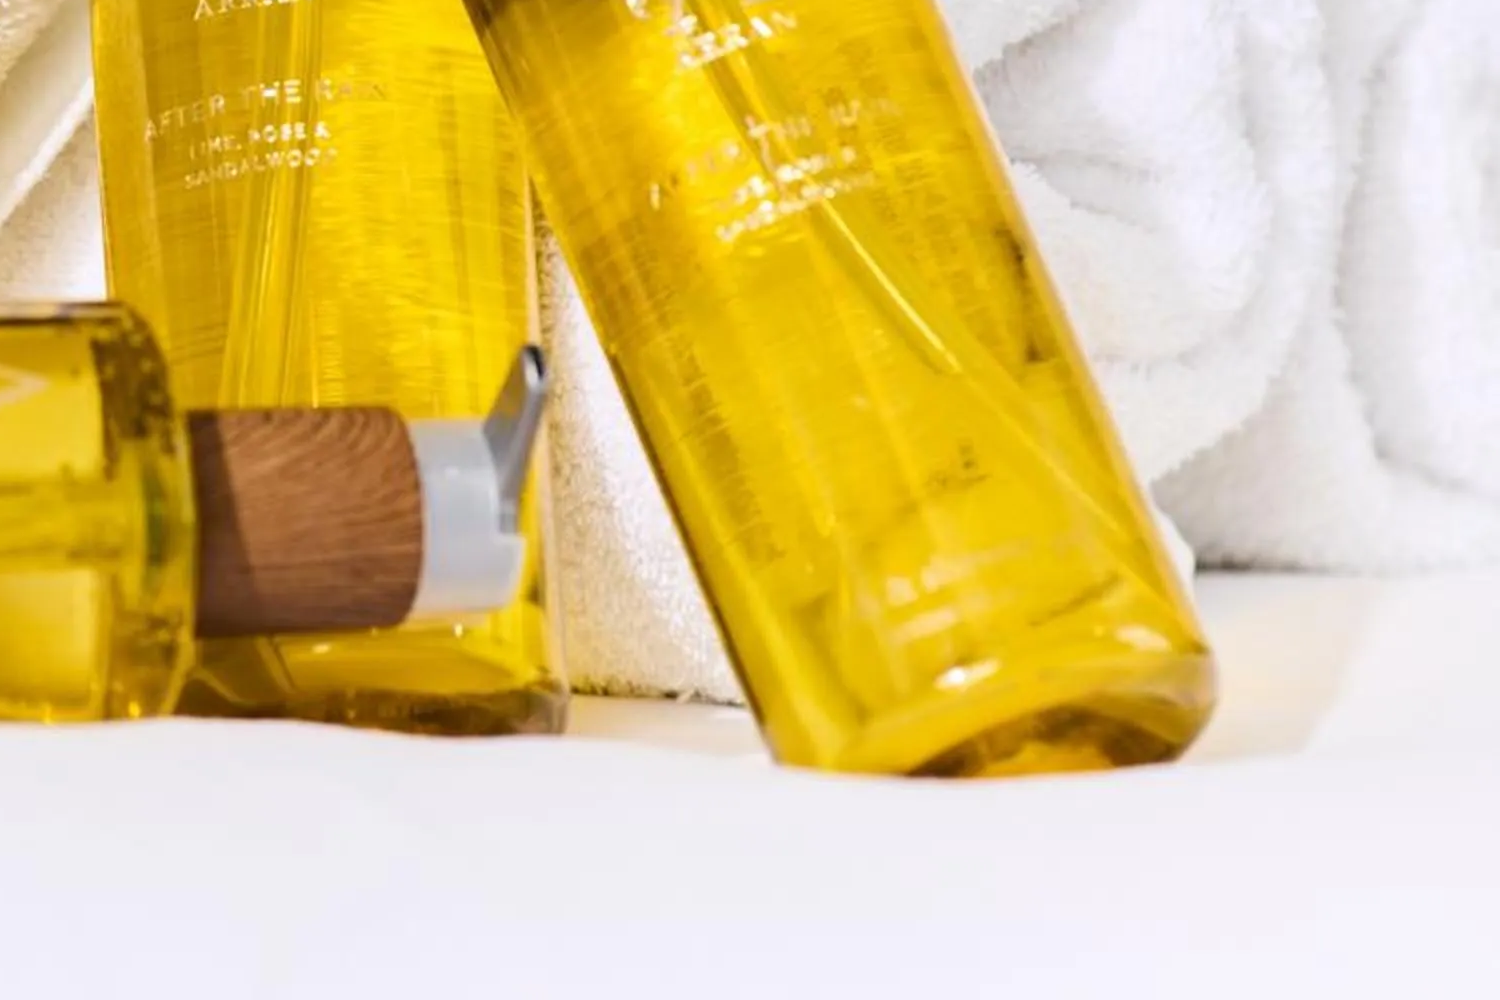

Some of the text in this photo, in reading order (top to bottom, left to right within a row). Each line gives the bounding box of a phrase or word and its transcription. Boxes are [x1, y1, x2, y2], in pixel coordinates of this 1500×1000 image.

[144, 94, 227, 144] AFTER
[241, 78, 303, 108] THE
[248, 121, 307, 147] ROSE
